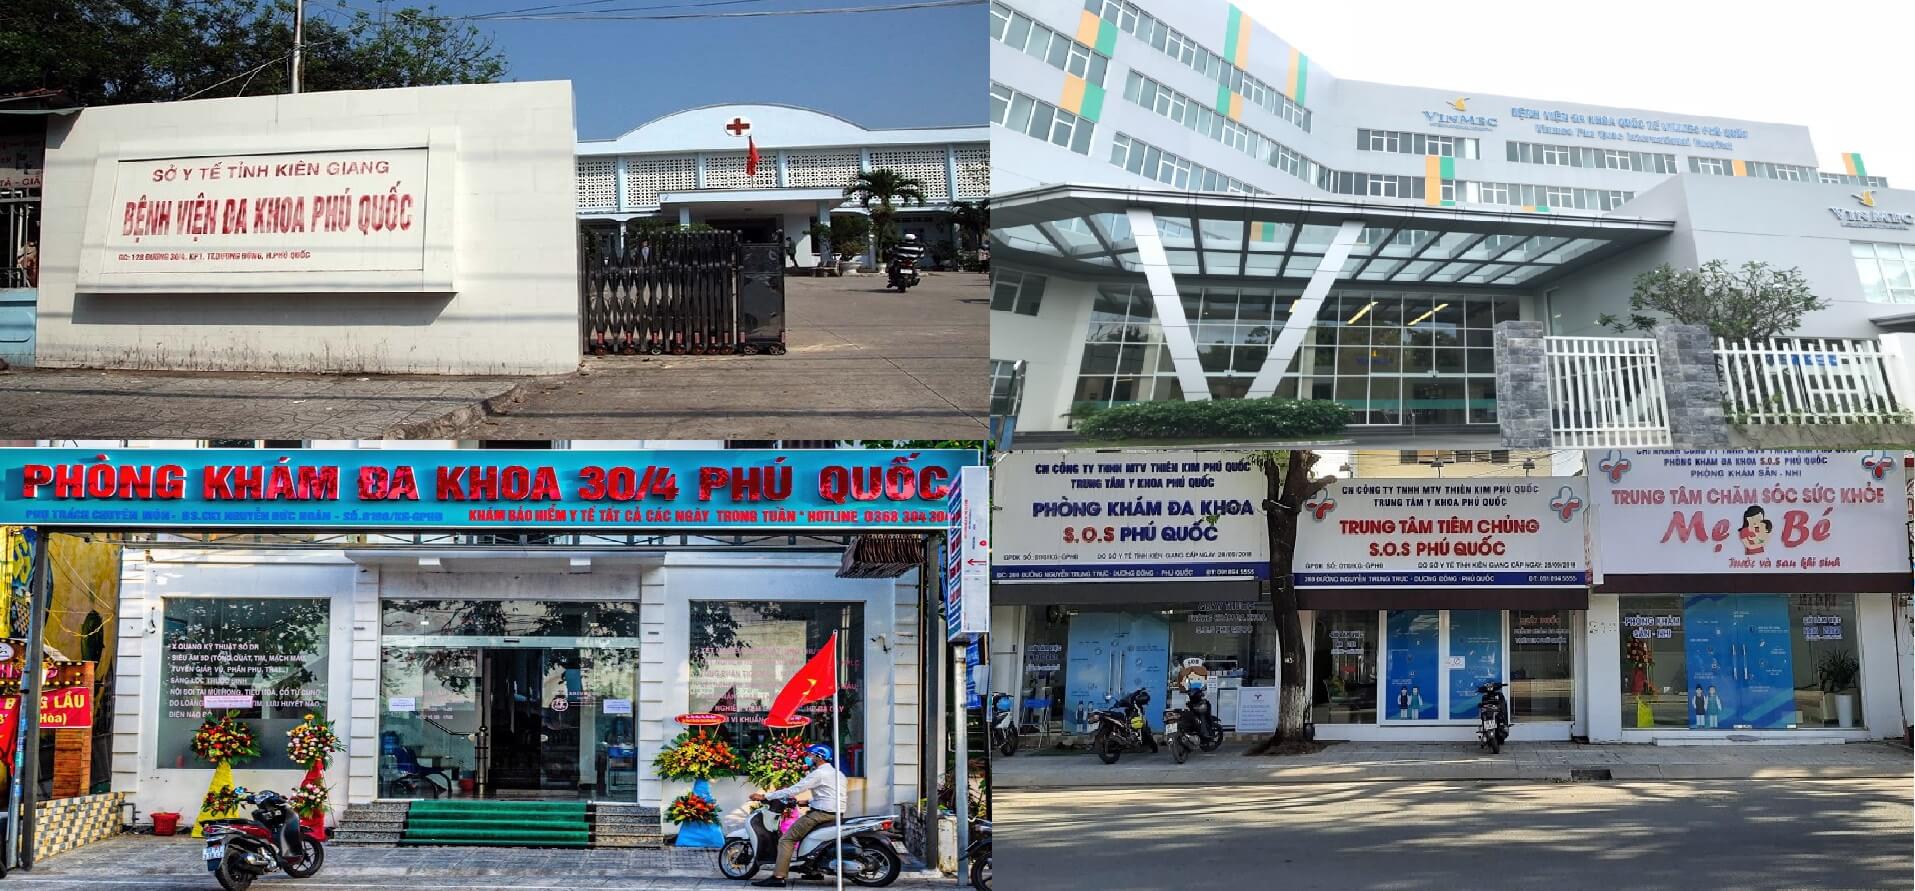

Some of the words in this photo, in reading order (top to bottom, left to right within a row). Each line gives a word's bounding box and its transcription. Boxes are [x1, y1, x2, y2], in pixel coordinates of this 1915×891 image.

[153, 164, 177, 182] SỞ
[183, 168, 192, 181] Y
[200, 161, 222, 180] TẾ
[227, 161, 269, 178] TỈNH
[275, 160, 319, 177] KIÊN
[327, 160, 389, 176] GIANG
[122, 194, 172, 243] BỆNH
[176, 192, 218, 242] VIỆN
[222, 198, 247, 235] ĐA
[253, 196, 305, 234] KHOA
[311, 187, 352, 233] PHÚ
[357, 180, 413, 236] QUỐC
[1052, 461, 1079, 474] CÔNG
[1083, 464, 1094, 474] TY
[1098, 463, 1122, 473] TNHH
[1125, 463, 1147, 473] MTV
[1150, 461, 1178, 473] THIÊN
[1182, 462, 1200, 472] KIM
[1203, 460, 1221, 472] PHÚ
[1663, 456, 1692, 466] PHÒNG
[1695, 456, 1718, 466] KHÁM
[1735, 457, 1756, 466] KHOA
[1760, 457, 1780, 466] S.O.S
[1784, 455, 1801, 466] PHÚ
[1804, 454, 1828, 465] QUỐC
[22, 453, 187, 499] PHÒNG
[203, 455, 340, 500] KHÁM
[357, 463, 419, 500] ĐA
[435, 465, 563, 501] KHOA
[578, 465, 679, 502] 30/4
[699, 456, 793, 502] PHÚ
[819, 452, 950, 505] QUỐC
[1690, 467, 1724, 477] PHÒNG
[1728, 467, 1755, 477] KHÁM
[1758, 466, 1778, 477] SẢN
[1785, 469, 1802, 477] NHI
[1071, 478, 1103, 489] TRUNG
[1105, 476, 1125, 488] TÂM
[1128, 478, 1136, 488] Y
[1137, 478, 1163, 488] KHOA
[1166, 475, 1185, 488] PHÚ
[1188, 473, 1215, 488] QUỐC
[1356, 484, 1380, 495] CÔNG
[1383, 486, 1393, 494] TY
[1396, 486, 1420, 495] TNHH
[1422, 486, 1441, 494] MTV
[1444, 484, 1471, 494] THIÊN
[1474, 486, 1491, 494] KIM
[1493, 484, 1511, 494] PHÚ
[1514, 482, 1539, 493] QUỐC
[1374, 498, 1403, 507] TRUNG
[1405, 496, 1424, 507] TÂM
[1427, 498, 1433, 507] Y
[1435, 498, 1459, 507] KHOA
[1462, 496, 1480, 507] PHÚ
[1482, 495, 1507, 507] QUỐC
[1611, 489, 1665, 504] TRUNG
[1669, 485, 1702, 504] TÂM
[1707, 485, 1757, 504] CHĂM
[1762, 483, 1797, 504] SÓC
[1803, 481, 1835, 504] SỨC
[1840, 481, 1885, 504] KHỎE
[468, 506, 505, 521] KHÁM
[508, 506, 532, 521] BẢO
[535, 503, 566, 521] HIỂM
[569, 509, 578, 521] Y
[580, 505, 595, 521] TẾ
[599, 505, 621, 522] TẤT
[625, 506, 641, 522] CẢ
[646, 506, 671, 522] CÁC
[675, 507, 709, 522] NGÀY
[717, 510, 757, 522] TRONG
[762, 506, 796, 522] TUẦN
[808, 510, 857, 522] HOTLINE
[864, 510, 898, 522] 0368
[929, 510, 948, 522] 30
[1032, 495, 1101, 517] PHÒNG
[1107, 495, 1162, 516] KHÁM
[1167, 501, 1194, 516] ĐA
[1200, 500, 1254, 516] KHOA
[1062, 527, 1115, 543] S.O.S
[1120, 520, 1155, 542] PHÚ
[1160, 518, 1218, 542] QUỐC
[1339, 519, 1396, 535] TRUNG
[1398, 515, 1433, 534] TÂM
[1437, 515, 1474, 534] TIÊM
[1477, 514, 1540, 534] CHỦNG
[1660, 510, 1730, 552] Mẹ
[1781, 506, 1834, 548] Bé
[1369, 542, 1410, 557] S.O.S
[1416, 537, 1450, 557] PHÚ
[1453, 535, 1506, 557] QUỐC
[1760, 557, 1771, 568] và
[1624, 614, 1654, 626] PHÒNG
[238, 642, 248, 650] SỐ
[188, 653, 199, 661] ÂM
